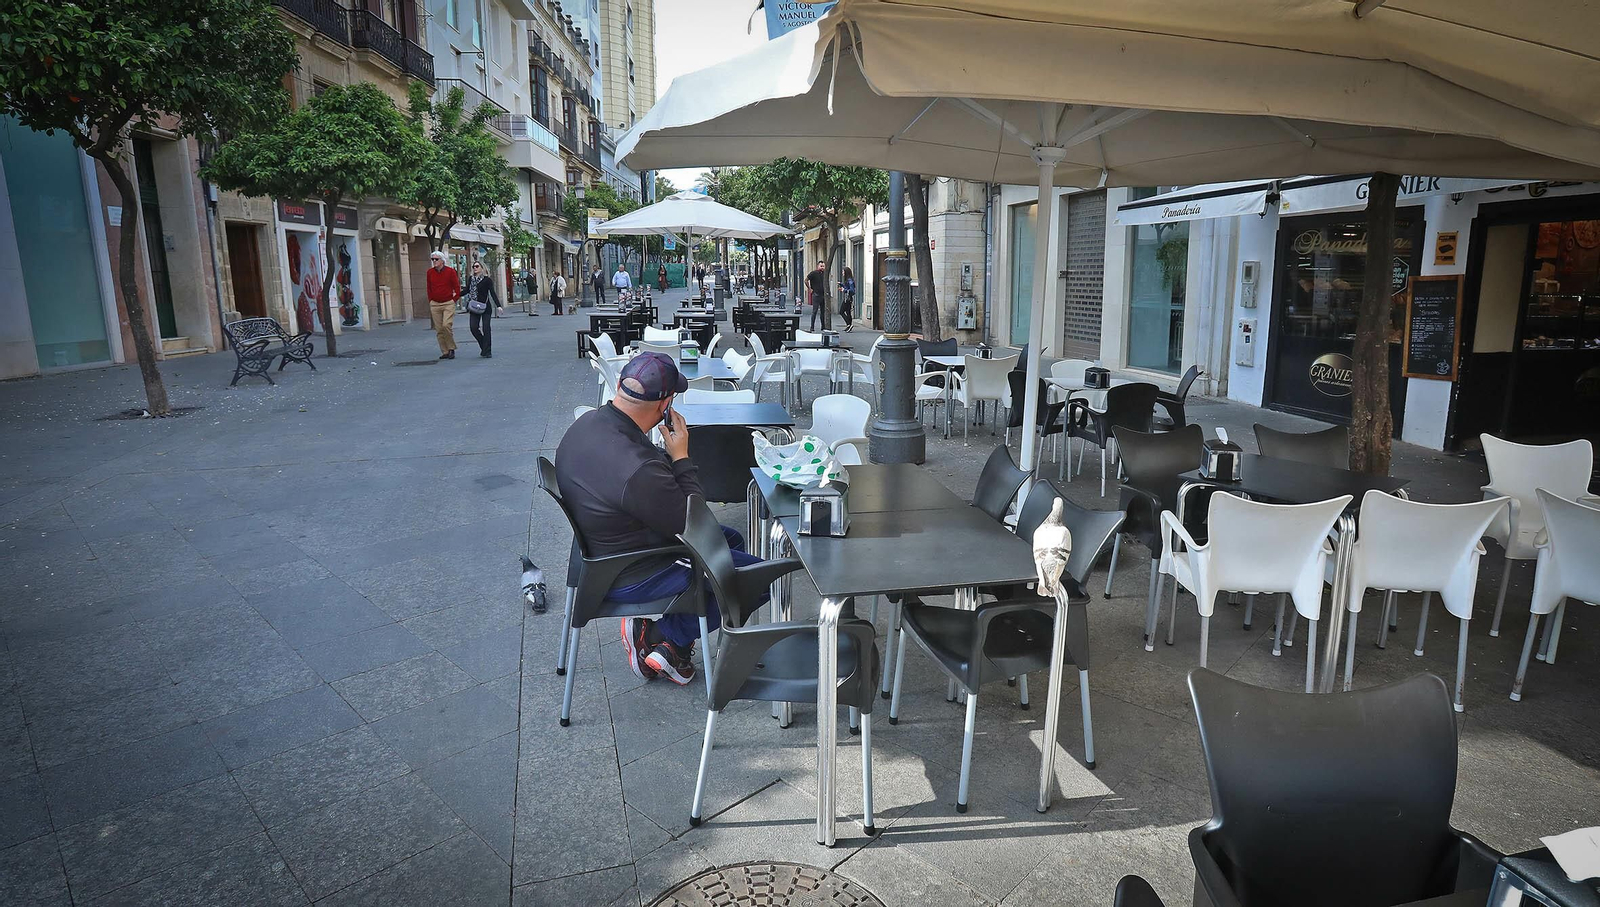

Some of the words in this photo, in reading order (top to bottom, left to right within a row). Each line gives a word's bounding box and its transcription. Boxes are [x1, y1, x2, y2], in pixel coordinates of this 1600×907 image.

[779, 12, 816, 20] MANUEL
[1356, 175, 1440, 200] GNIER
[1161, 204, 1201, 218] Panadería
[1310, 365, 1354, 382] GRANIE
